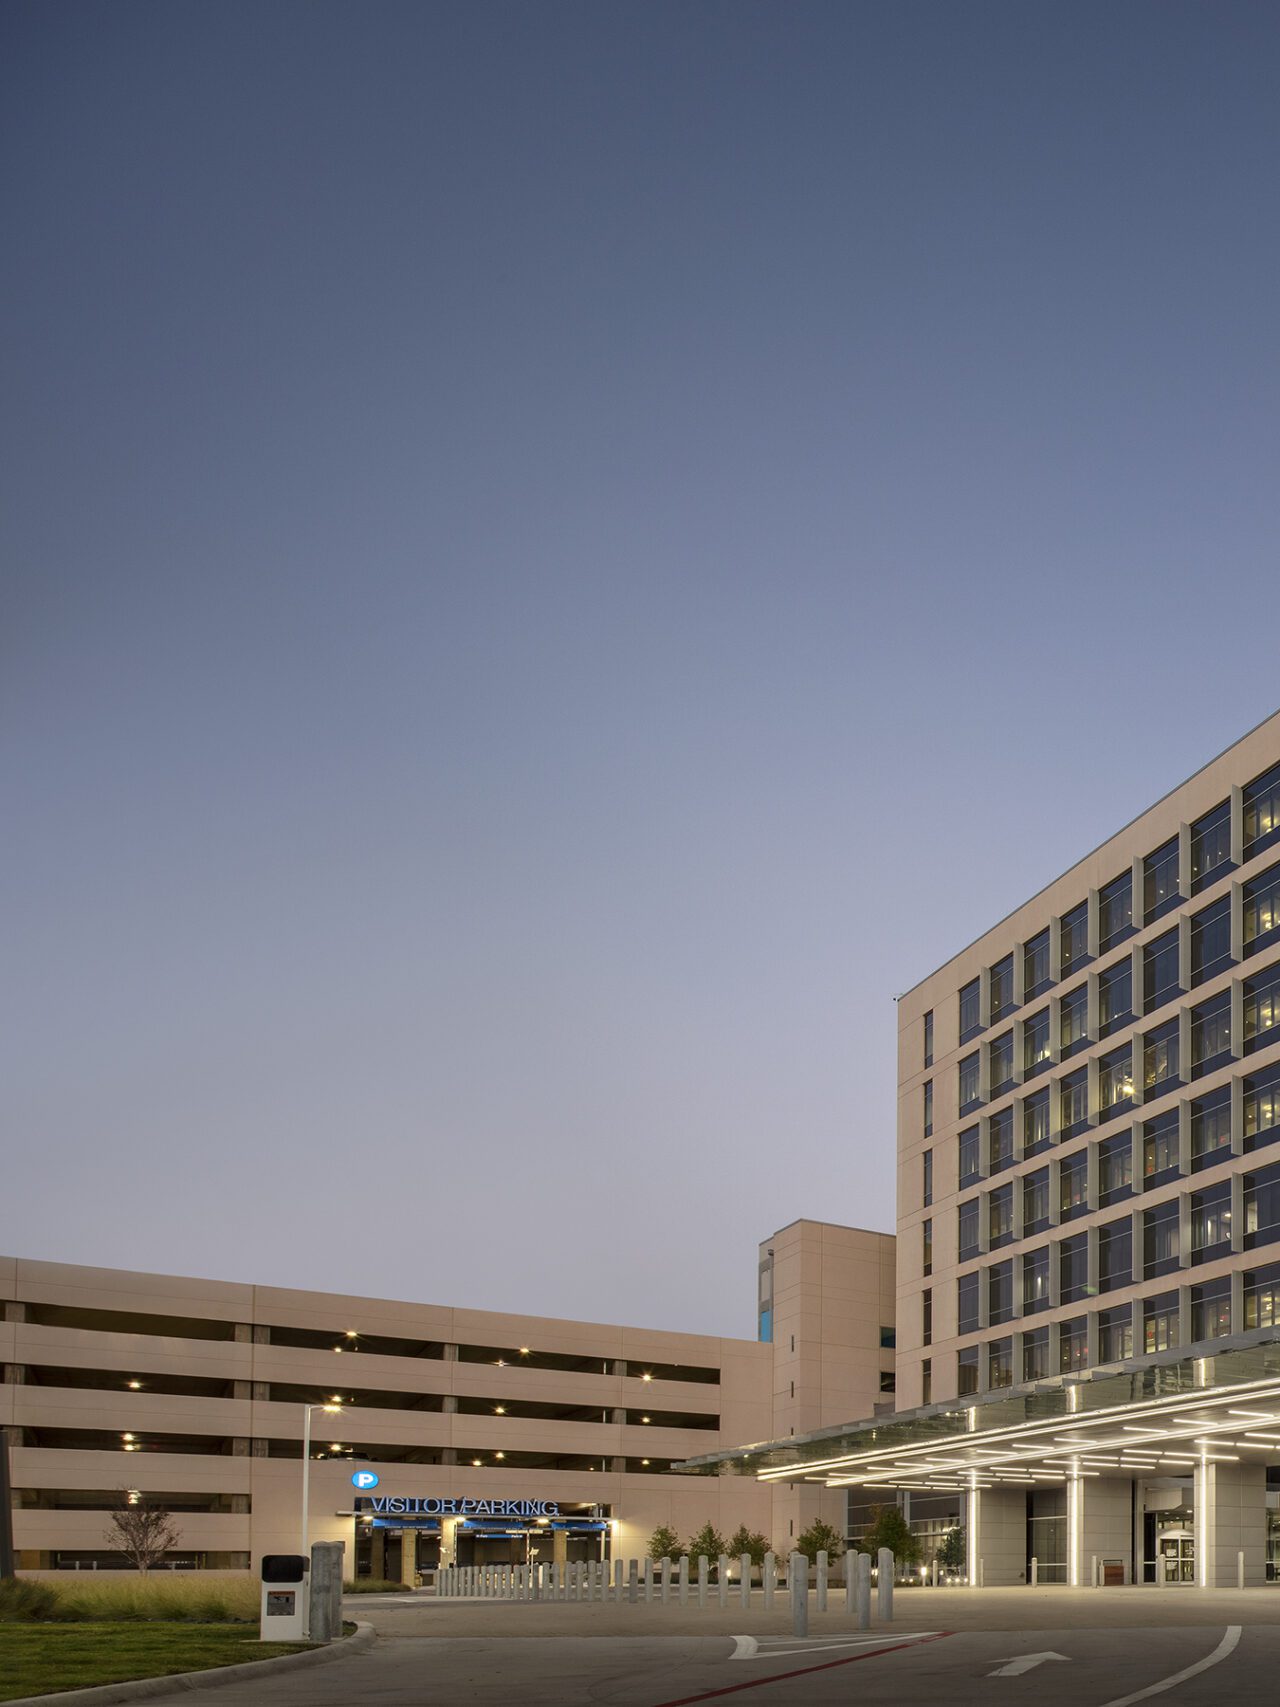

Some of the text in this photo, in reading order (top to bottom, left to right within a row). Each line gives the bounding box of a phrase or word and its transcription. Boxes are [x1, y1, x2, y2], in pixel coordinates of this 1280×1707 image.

[358, 1473, 374, 1487] P
[371, 1496, 559, 1516] VISITOR PARKING
